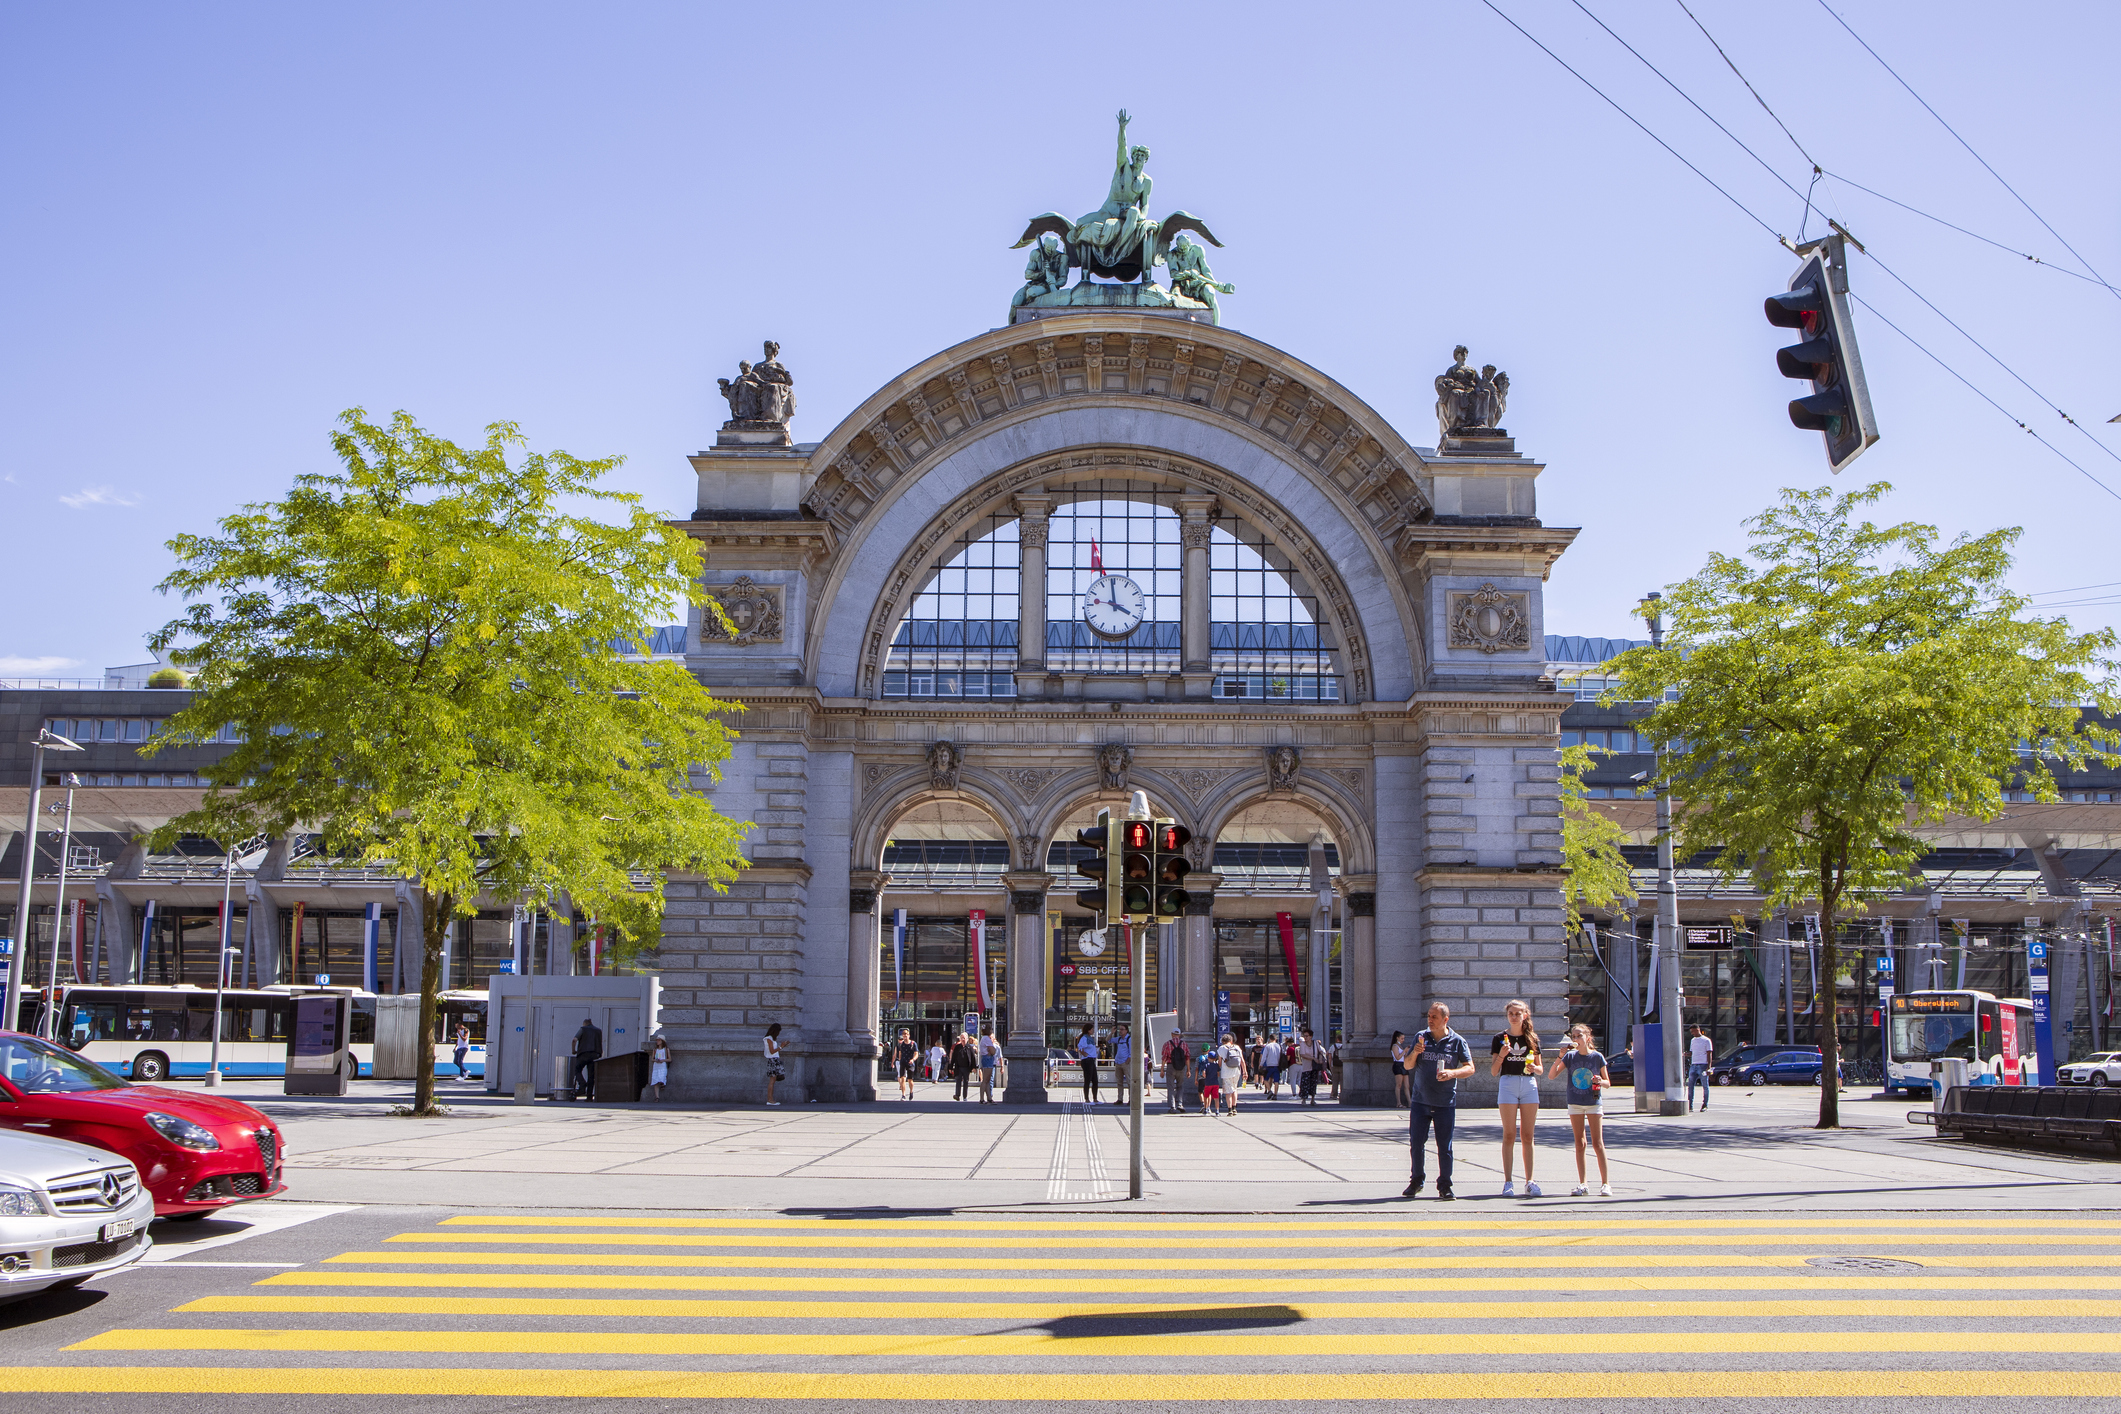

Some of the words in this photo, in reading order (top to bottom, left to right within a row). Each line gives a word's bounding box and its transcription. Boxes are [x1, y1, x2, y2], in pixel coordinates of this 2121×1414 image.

[2032, 945, 2043, 955] G
[1881, 960, 1889, 969] H
[1896, 999, 1904, 1007] 10
